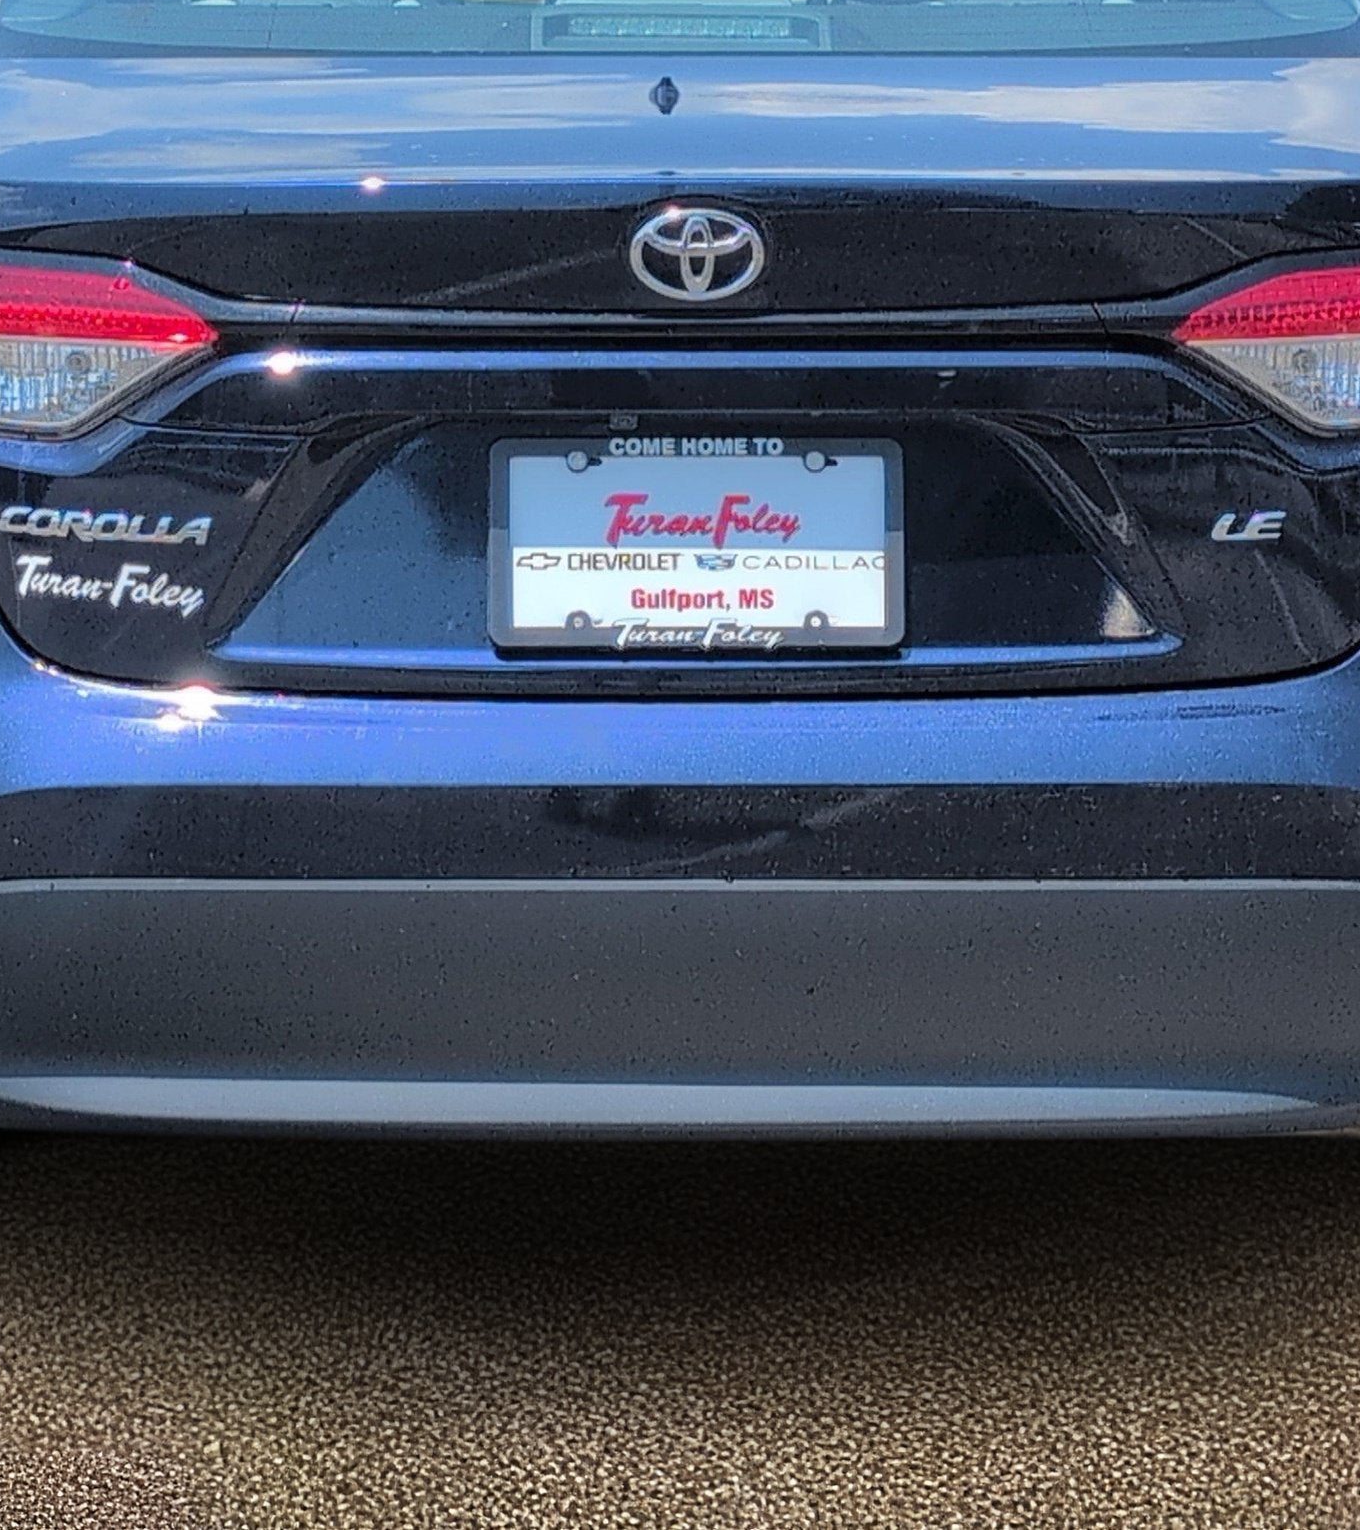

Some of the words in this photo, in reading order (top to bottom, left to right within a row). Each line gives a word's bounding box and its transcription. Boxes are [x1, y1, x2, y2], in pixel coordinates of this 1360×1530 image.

[608, 437, 676, 456] COME
[681, 437, 748, 456] HOME
[752, 437, 785, 456] TO
[1211, 510, 1287, 541] LE
[567, 553, 683, 571] CHEVROLET
[630, 588, 731, 612] Gulfport,
[739, 588, 775, 610] MS
